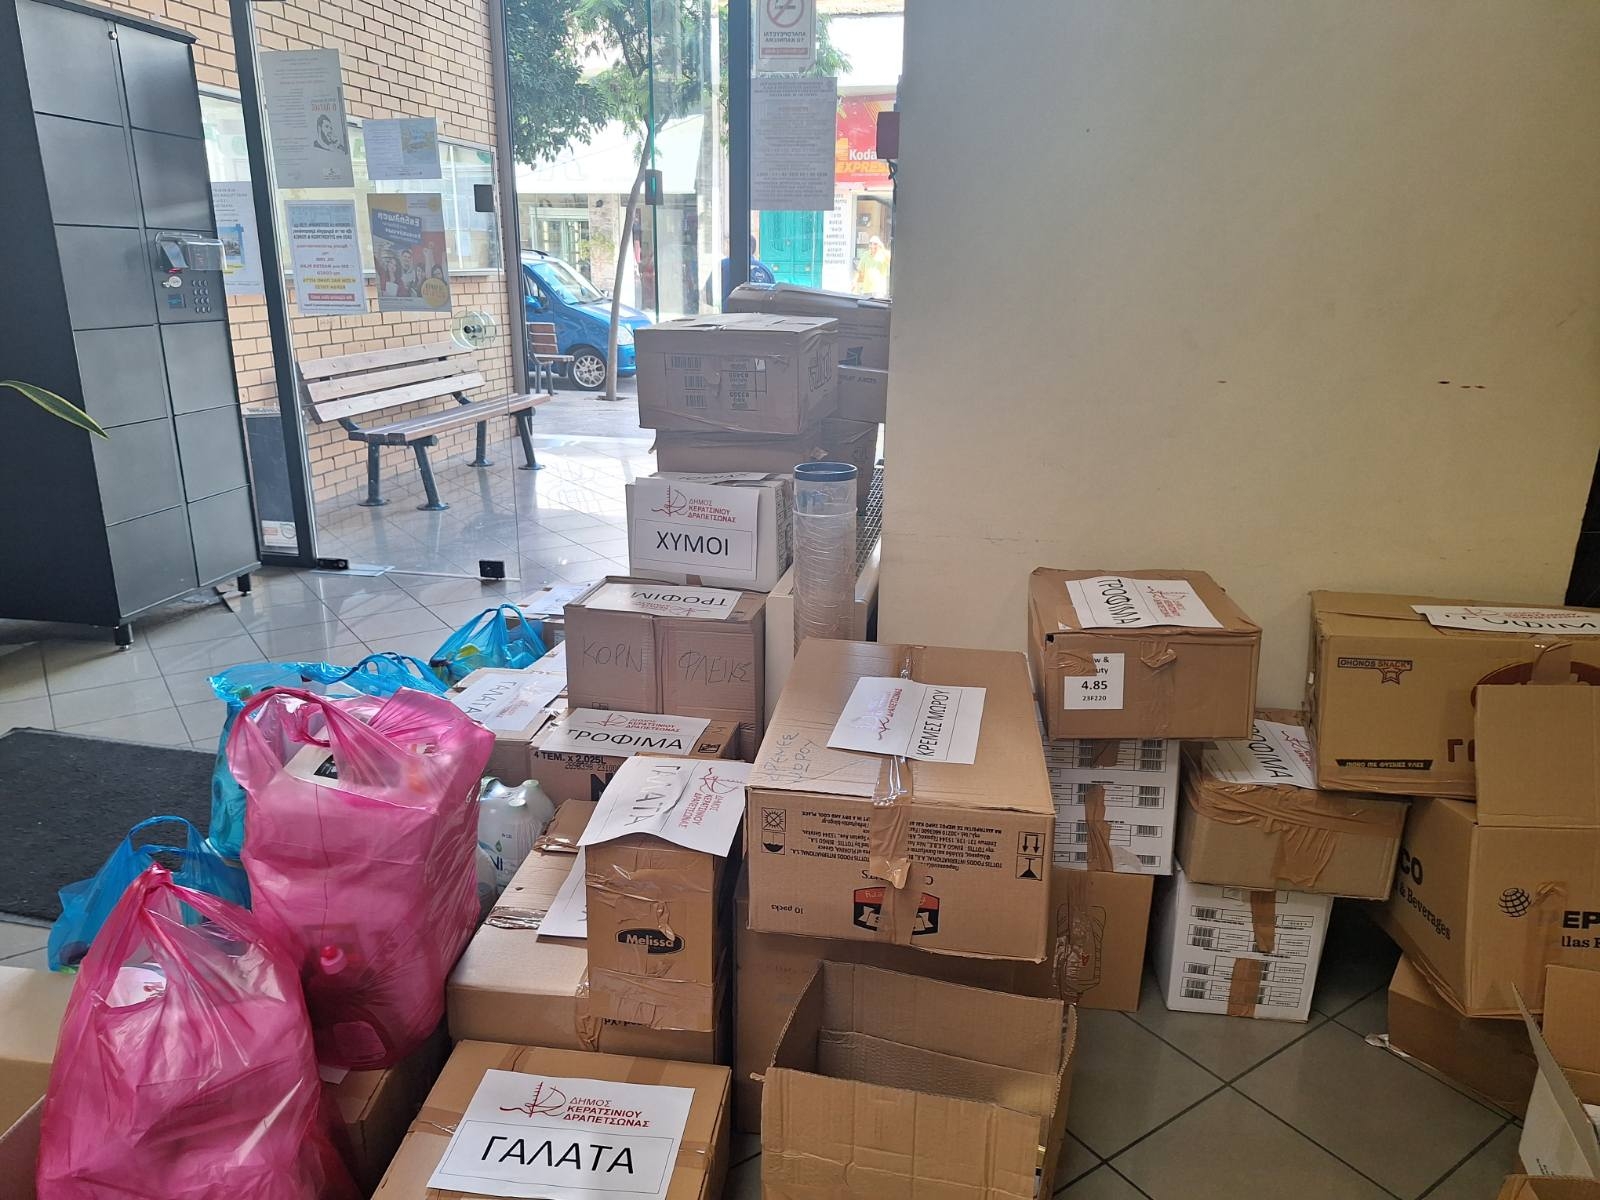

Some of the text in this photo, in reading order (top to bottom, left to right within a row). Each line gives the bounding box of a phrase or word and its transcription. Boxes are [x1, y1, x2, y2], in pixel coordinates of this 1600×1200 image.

[849, 148, 878, 161] Koda
[836, 161, 889, 174] EXPRES
[688, 505, 731, 516] ΚΕΡΑΤΣΙΝΙΟΥ
[687, 512, 736, 523] ΔΡΑΠΕΤΣΩΝΑΣ
[656, 530, 729, 556] ΧΥΜΟΙ
[631, 591, 728, 607] ΤΡΟΦΙΜ
[1097, 578, 1142, 625] ΤΡΟΦΙΜΑ
[1096, 667, 1109, 675] uty
[1081, 680, 1108, 690] 4.85
[915, 689, 950, 757] ΚΡΕΜΕΣ ΜΩΡΟΥ
[567, 729, 683, 750] ΤΡΟΦΙΜΑ
[801, 850, 836, 859] INTERNATIONAL
[926, 856, 966, 865] INTERNATIONAL
[1401, 849, 1424, 886] CO
[771, 904, 804, 915] 10 packs
[1406, 887, 1452, 941] Beverages
[626, 934, 674, 947] Melissa
[1561, 935, 1591, 948] llas
[569, 1096, 612, 1108] ΔΗΜΟΣ
[566, 1105, 642, 1119] ΚΕΡΑΤΣΙΝΙΟΥ
[562, 1114, 651, 1128] ΔΡΑΠΕΤΣΩΝΑΣ
[481, 1135, 635, 1175] ΓΑΛΑΤΑ
